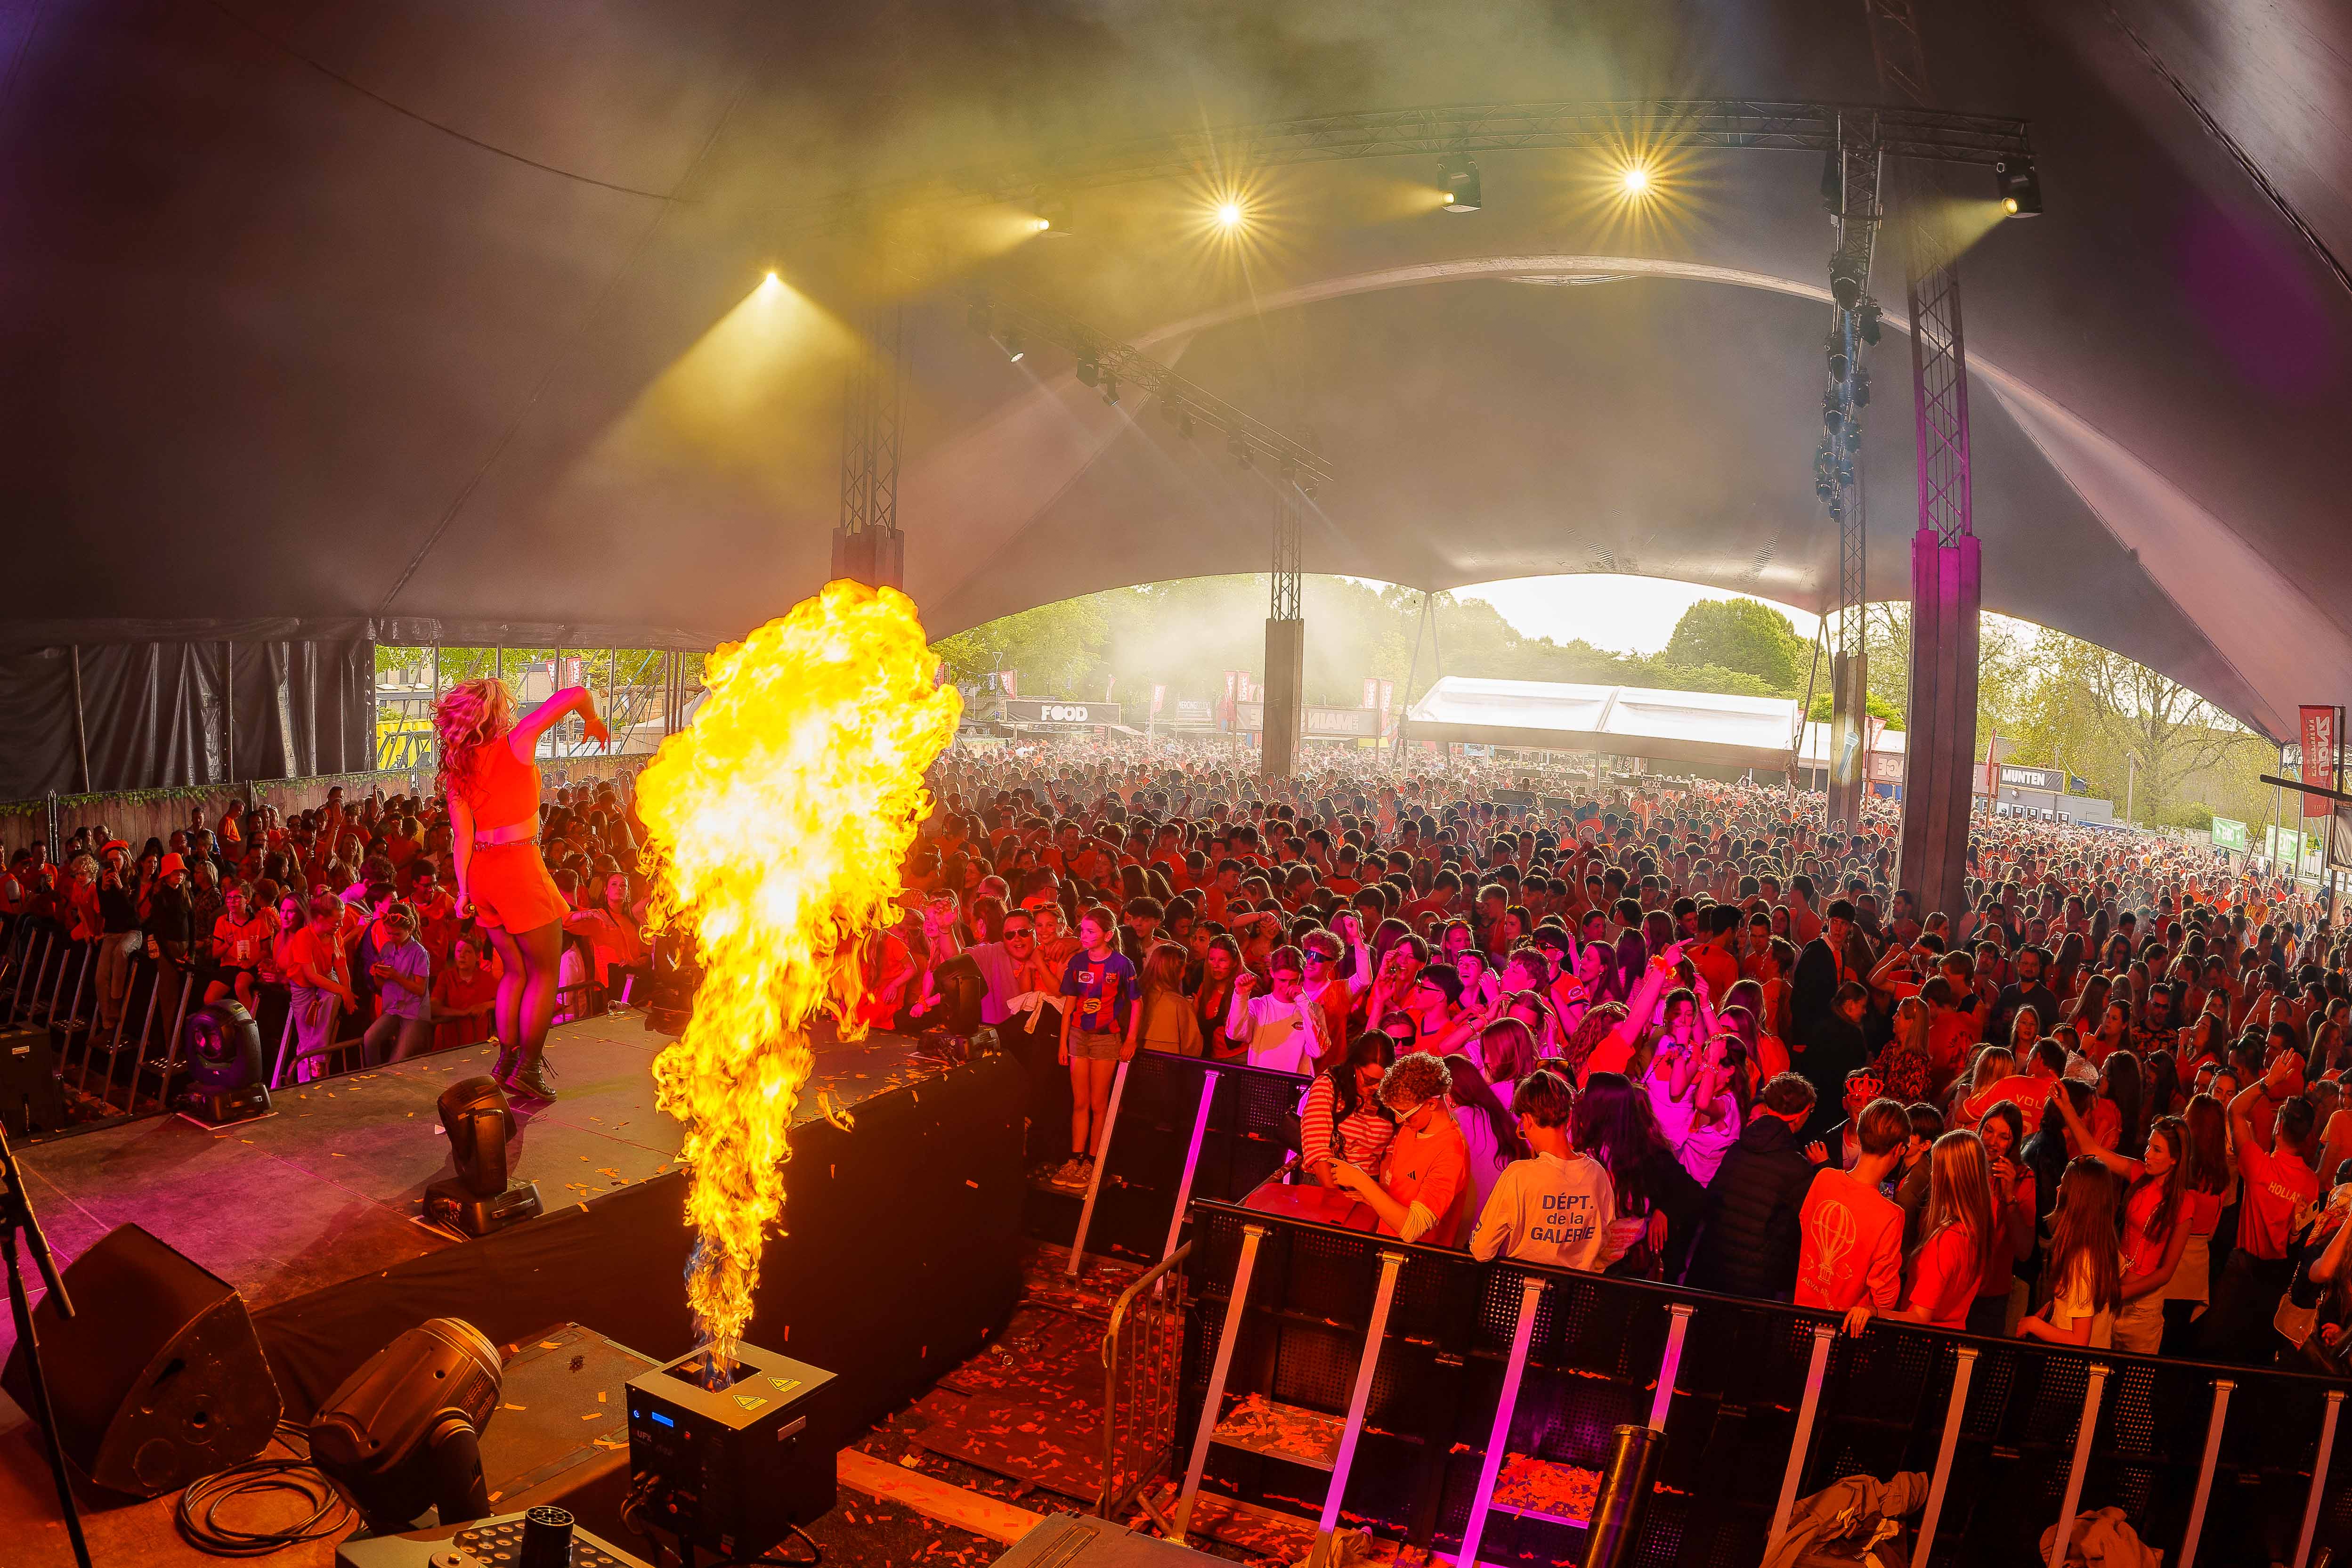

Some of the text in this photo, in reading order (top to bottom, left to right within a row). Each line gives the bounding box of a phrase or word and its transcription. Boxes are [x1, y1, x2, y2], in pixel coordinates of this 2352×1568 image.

[1041, 705, 1088, 722] FOOD
[2002, 768, 2045, 786] MUNTEN
[1542, 1192, 1594, 1210] DÉPT.
[1547, 1212, 1584, 1225] de la
[1531, 1226, 1595, 1244] GALERIE
